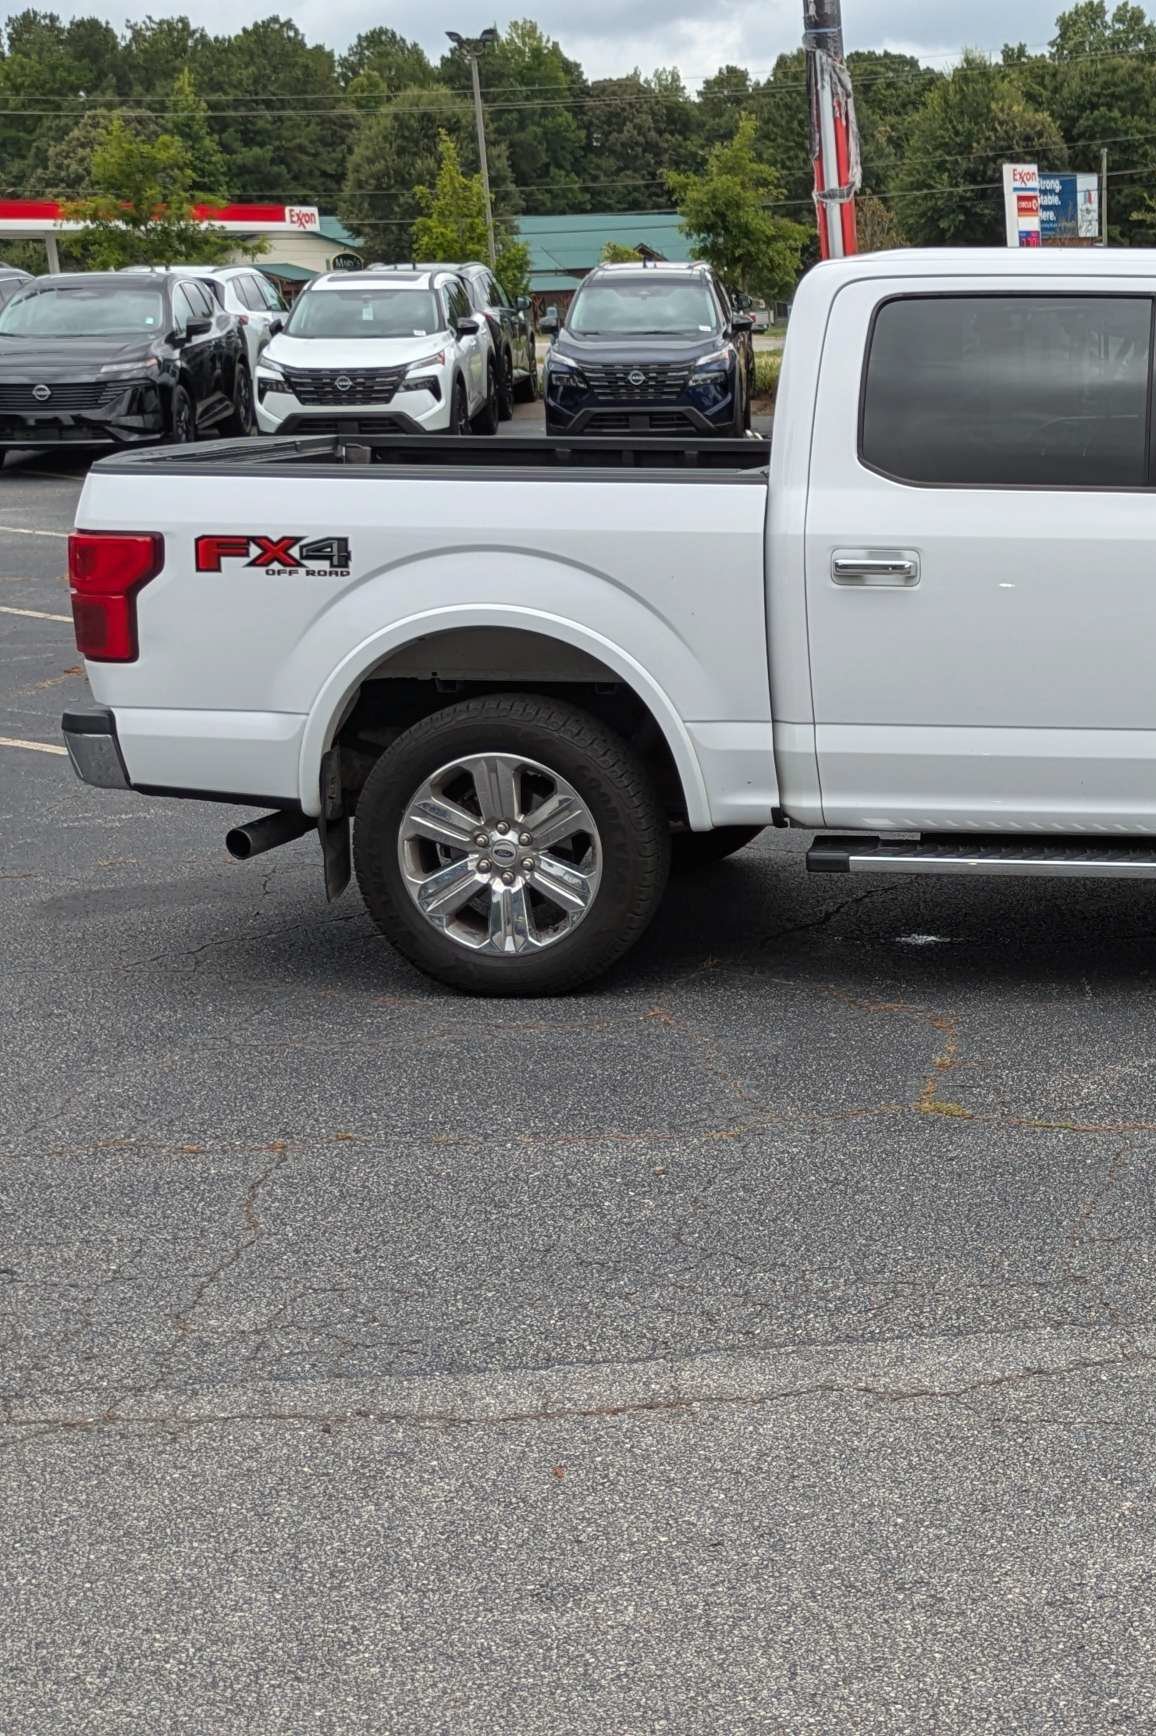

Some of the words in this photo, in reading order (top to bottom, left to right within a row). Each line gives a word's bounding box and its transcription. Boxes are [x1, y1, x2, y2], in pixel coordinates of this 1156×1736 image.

[1012, 168, 1037, 187] Exxon
[1039, 178, 1062, 193] trong.
[1039, 194, 1061, 206] table.
[288, 208, 317, 229] Exxon
[194, 535, 352, 572] FX4
[265, 568, 300, 577] OFF
[305, 568, 351, 578] ROAD
